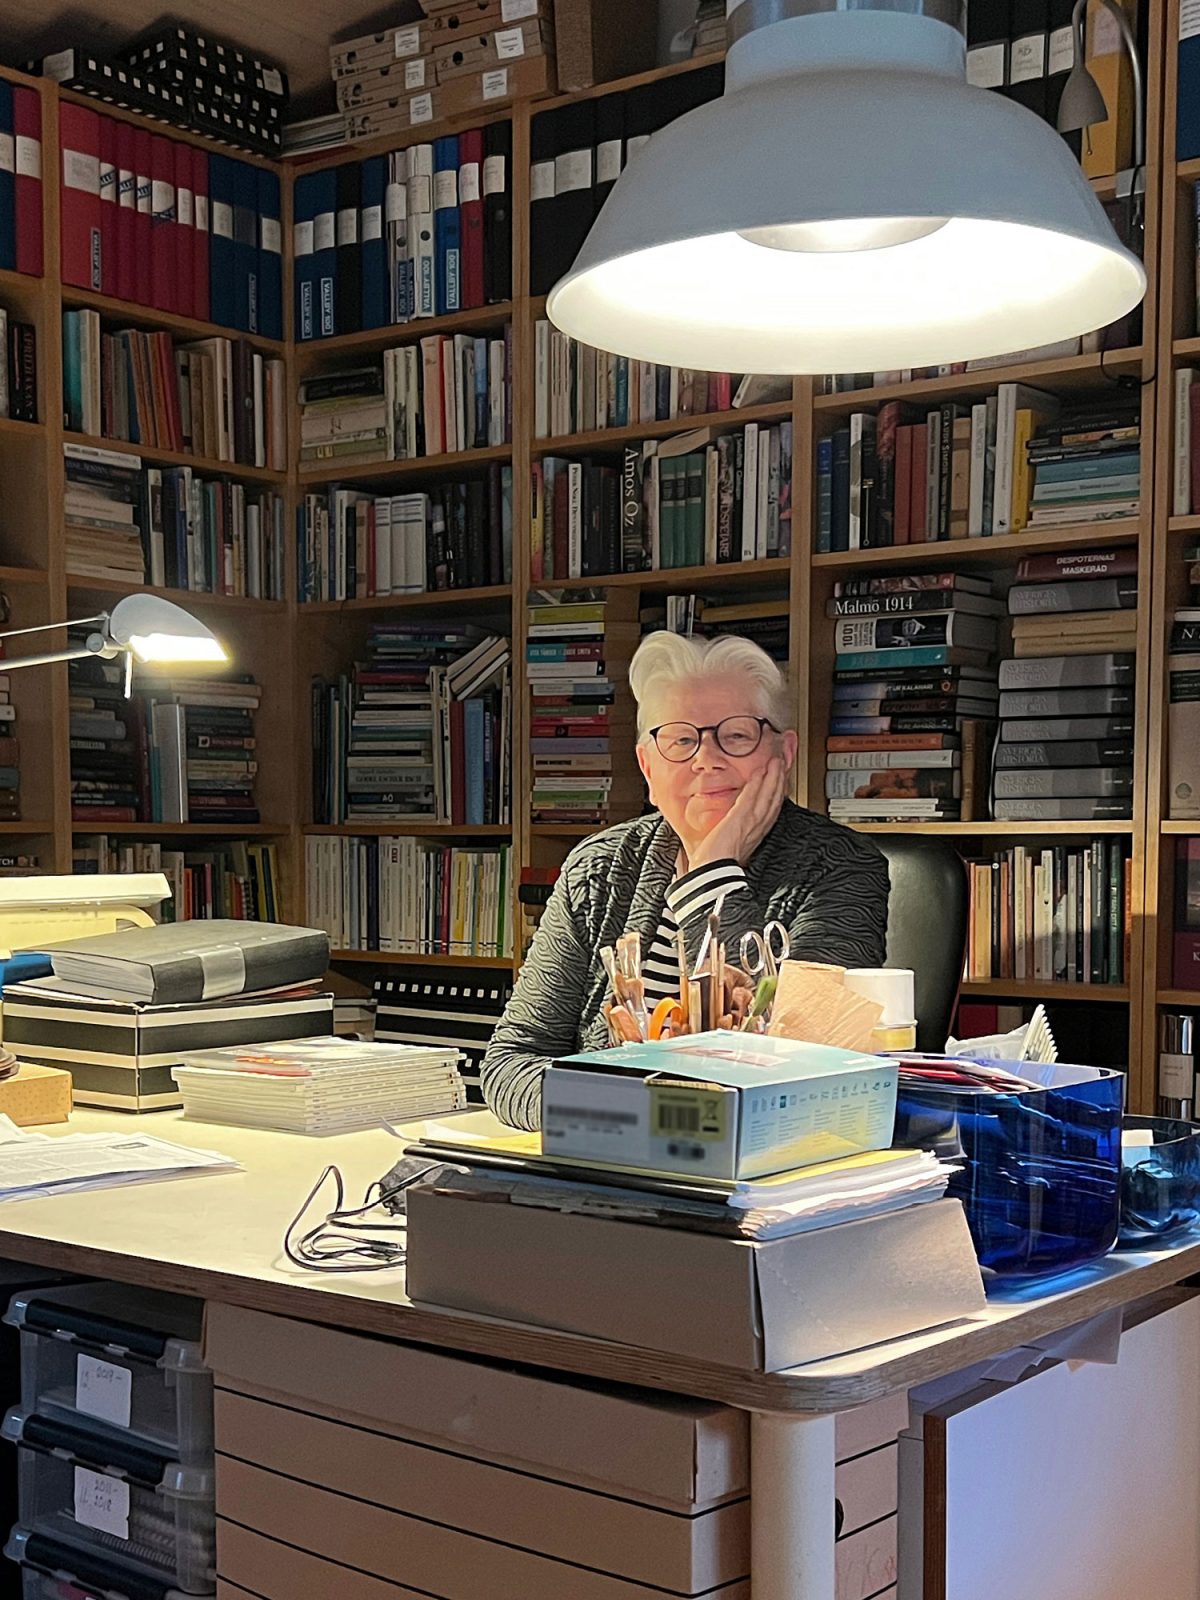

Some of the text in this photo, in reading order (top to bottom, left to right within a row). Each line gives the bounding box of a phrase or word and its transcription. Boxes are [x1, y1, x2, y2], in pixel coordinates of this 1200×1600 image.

[323, 315, 331, 330] 100
[624, 447, 639, 527] Amos Oz
[1056, 553, 1115, 565] DESPOTERNAS
[1062, 565, 1108, 575] MASKERAD
[834, 596, 914, 615] Malmö 1914
[842, 623, 854, 647] 1001
